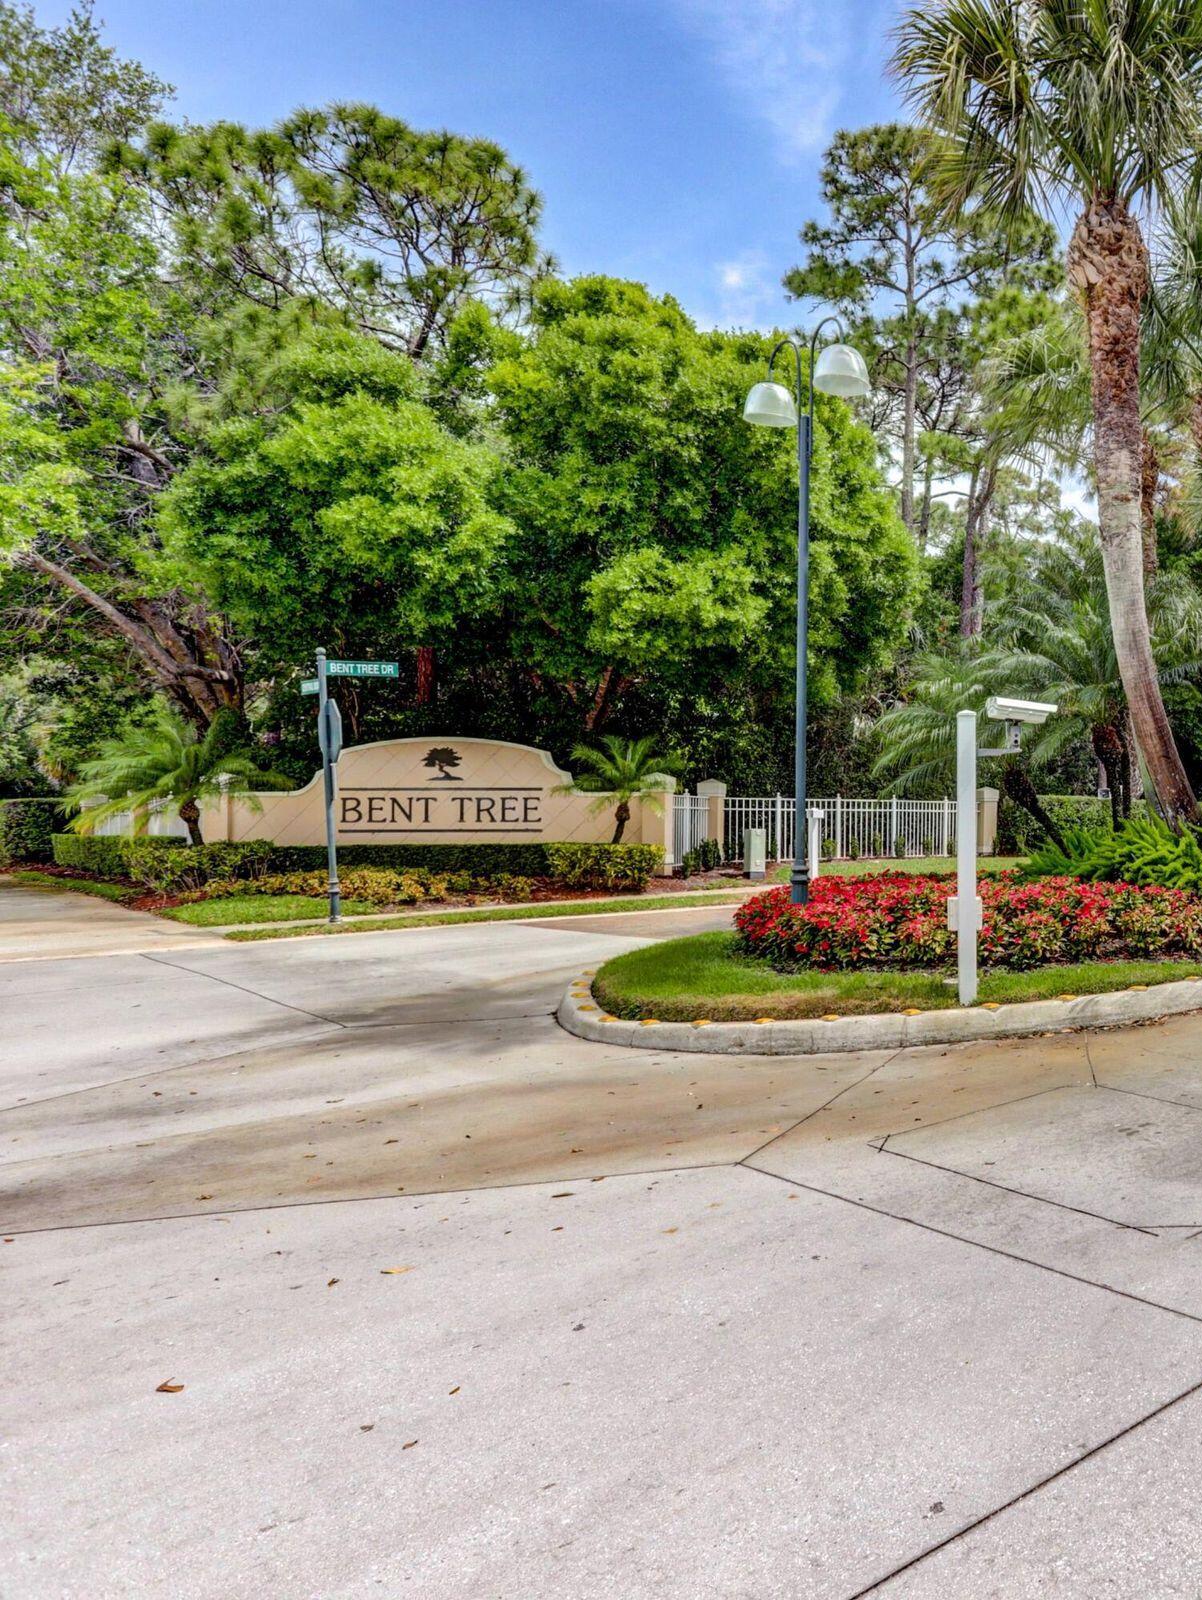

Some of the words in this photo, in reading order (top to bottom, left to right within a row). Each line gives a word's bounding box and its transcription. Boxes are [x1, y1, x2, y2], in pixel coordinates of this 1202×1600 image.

[330, 663, 354, 673] BENT
[355, 664, 379, 674] TREE
[381, 664, 394, 674] DR
[340, 797, 438, 823] BENT
[452, 797, 542, 823] TREE
